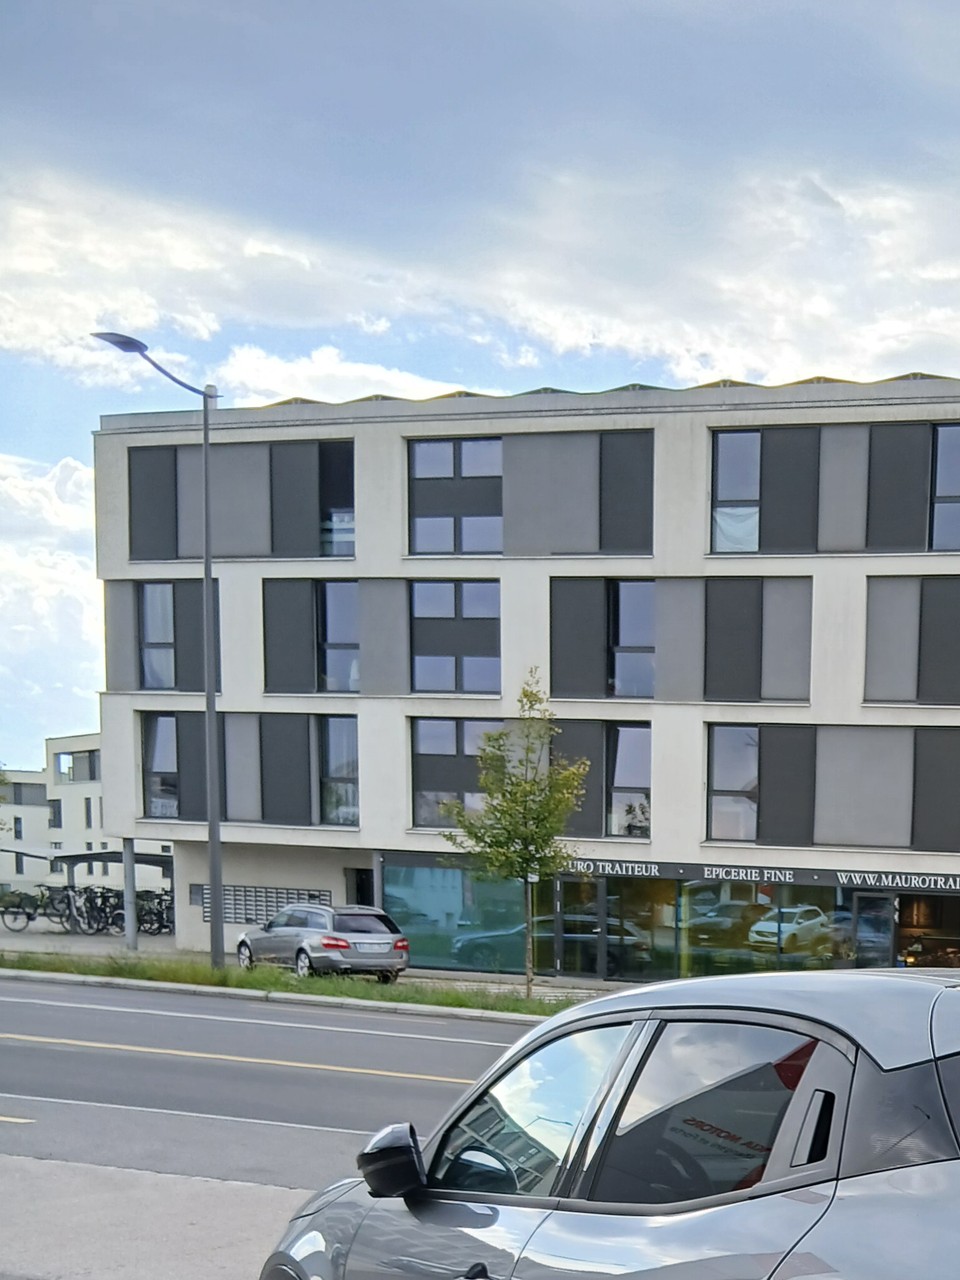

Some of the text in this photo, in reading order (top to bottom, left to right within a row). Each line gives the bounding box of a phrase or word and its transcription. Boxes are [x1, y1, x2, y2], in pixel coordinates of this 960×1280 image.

[557, 860, 660, 877] URO TRAITEUR
[703, 867, 794, 882] EPICERIE FINE
